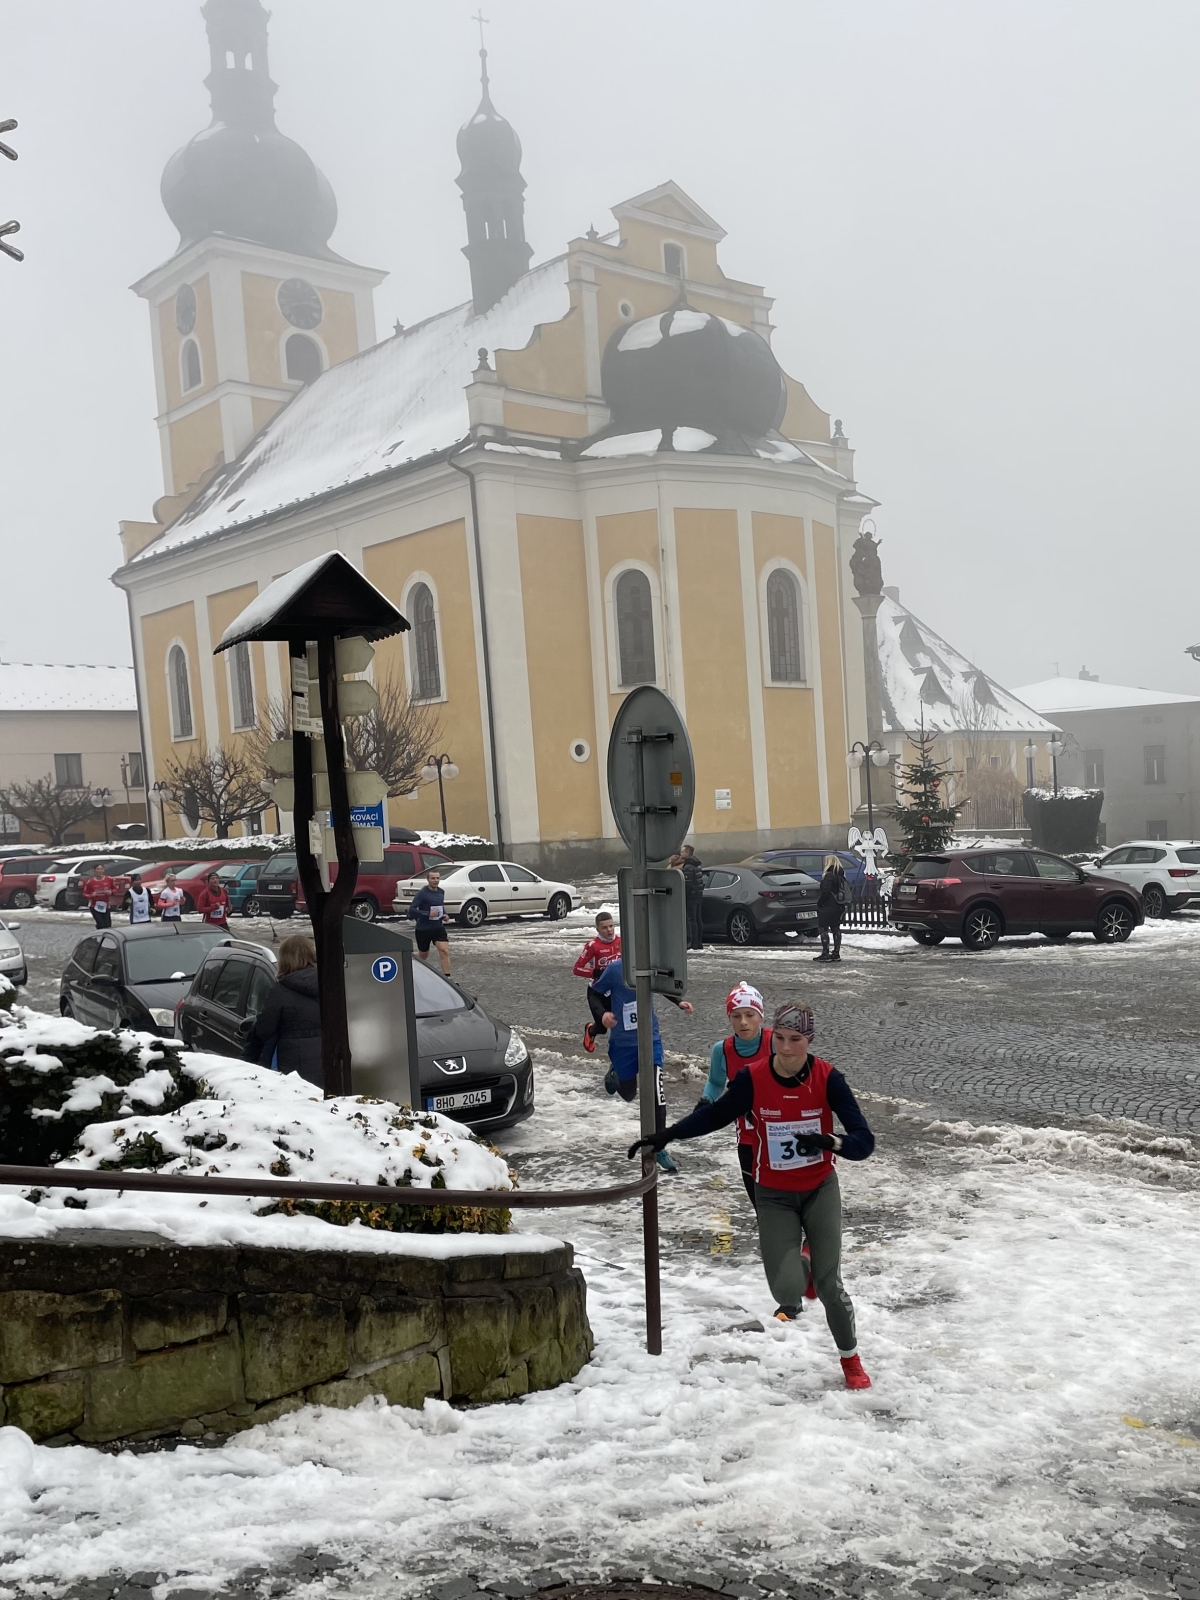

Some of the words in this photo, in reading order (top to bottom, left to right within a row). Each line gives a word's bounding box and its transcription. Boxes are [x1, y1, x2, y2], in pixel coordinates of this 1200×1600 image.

[350, 812, 379, 821] KOVACÍ
[379, 961, 392, 978] P
[462, 1091, 487, 1105] 2045
